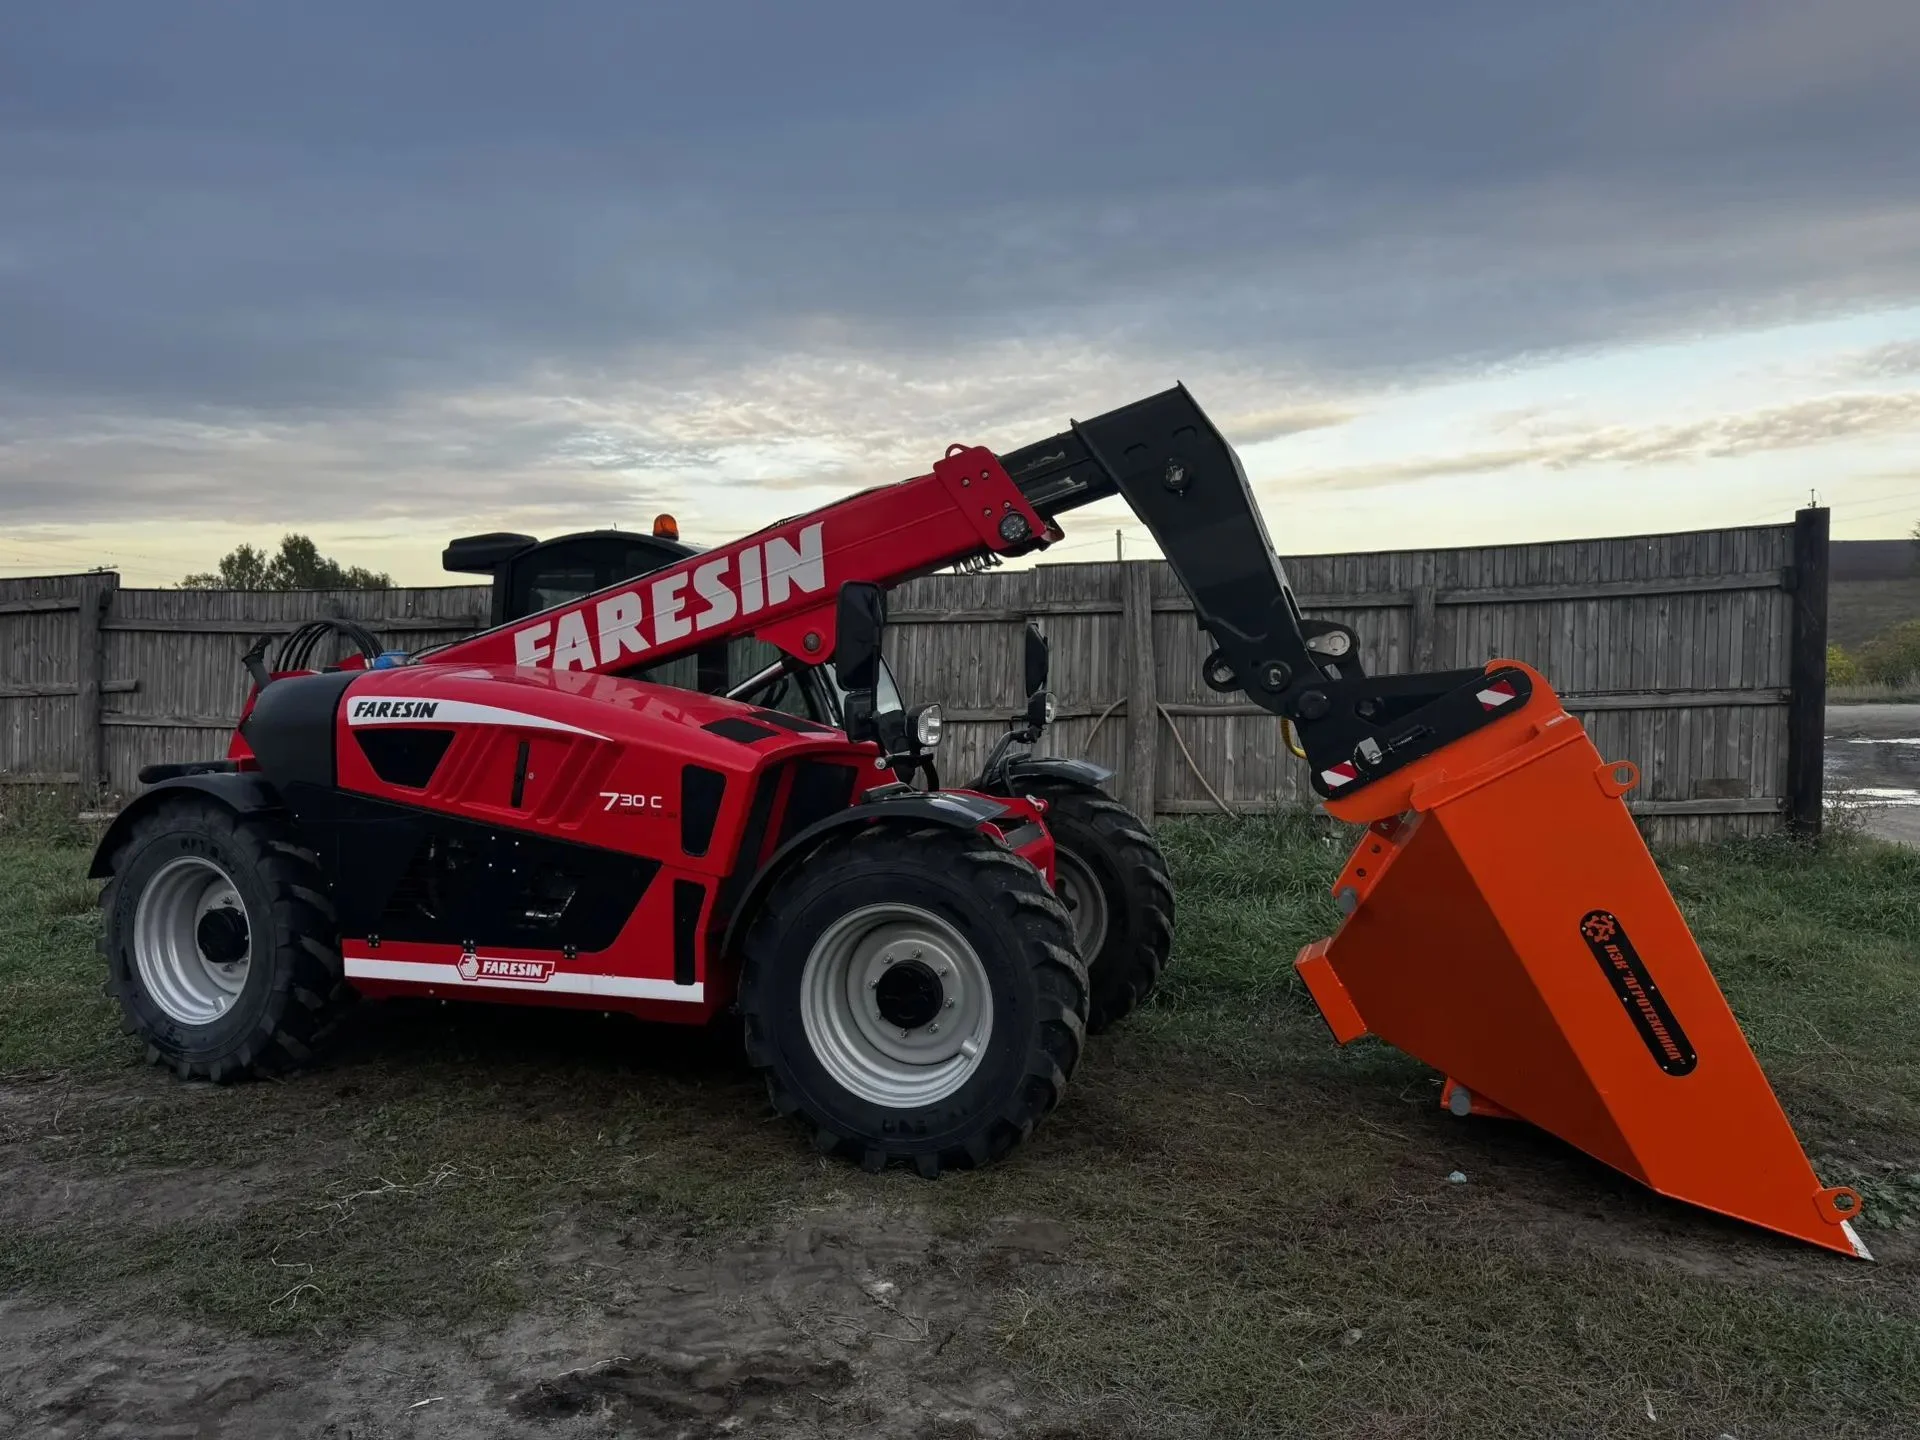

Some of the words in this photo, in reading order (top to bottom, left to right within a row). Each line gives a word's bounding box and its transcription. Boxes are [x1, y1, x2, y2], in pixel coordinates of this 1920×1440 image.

[514, 521, 826, 672] FARESIN
[353, 701, 440, 718] FARESIN
[600, 792, 645, 811] 730
[650, 796, 663, 809] C
[482, 961, 543, 977] FARESIN
